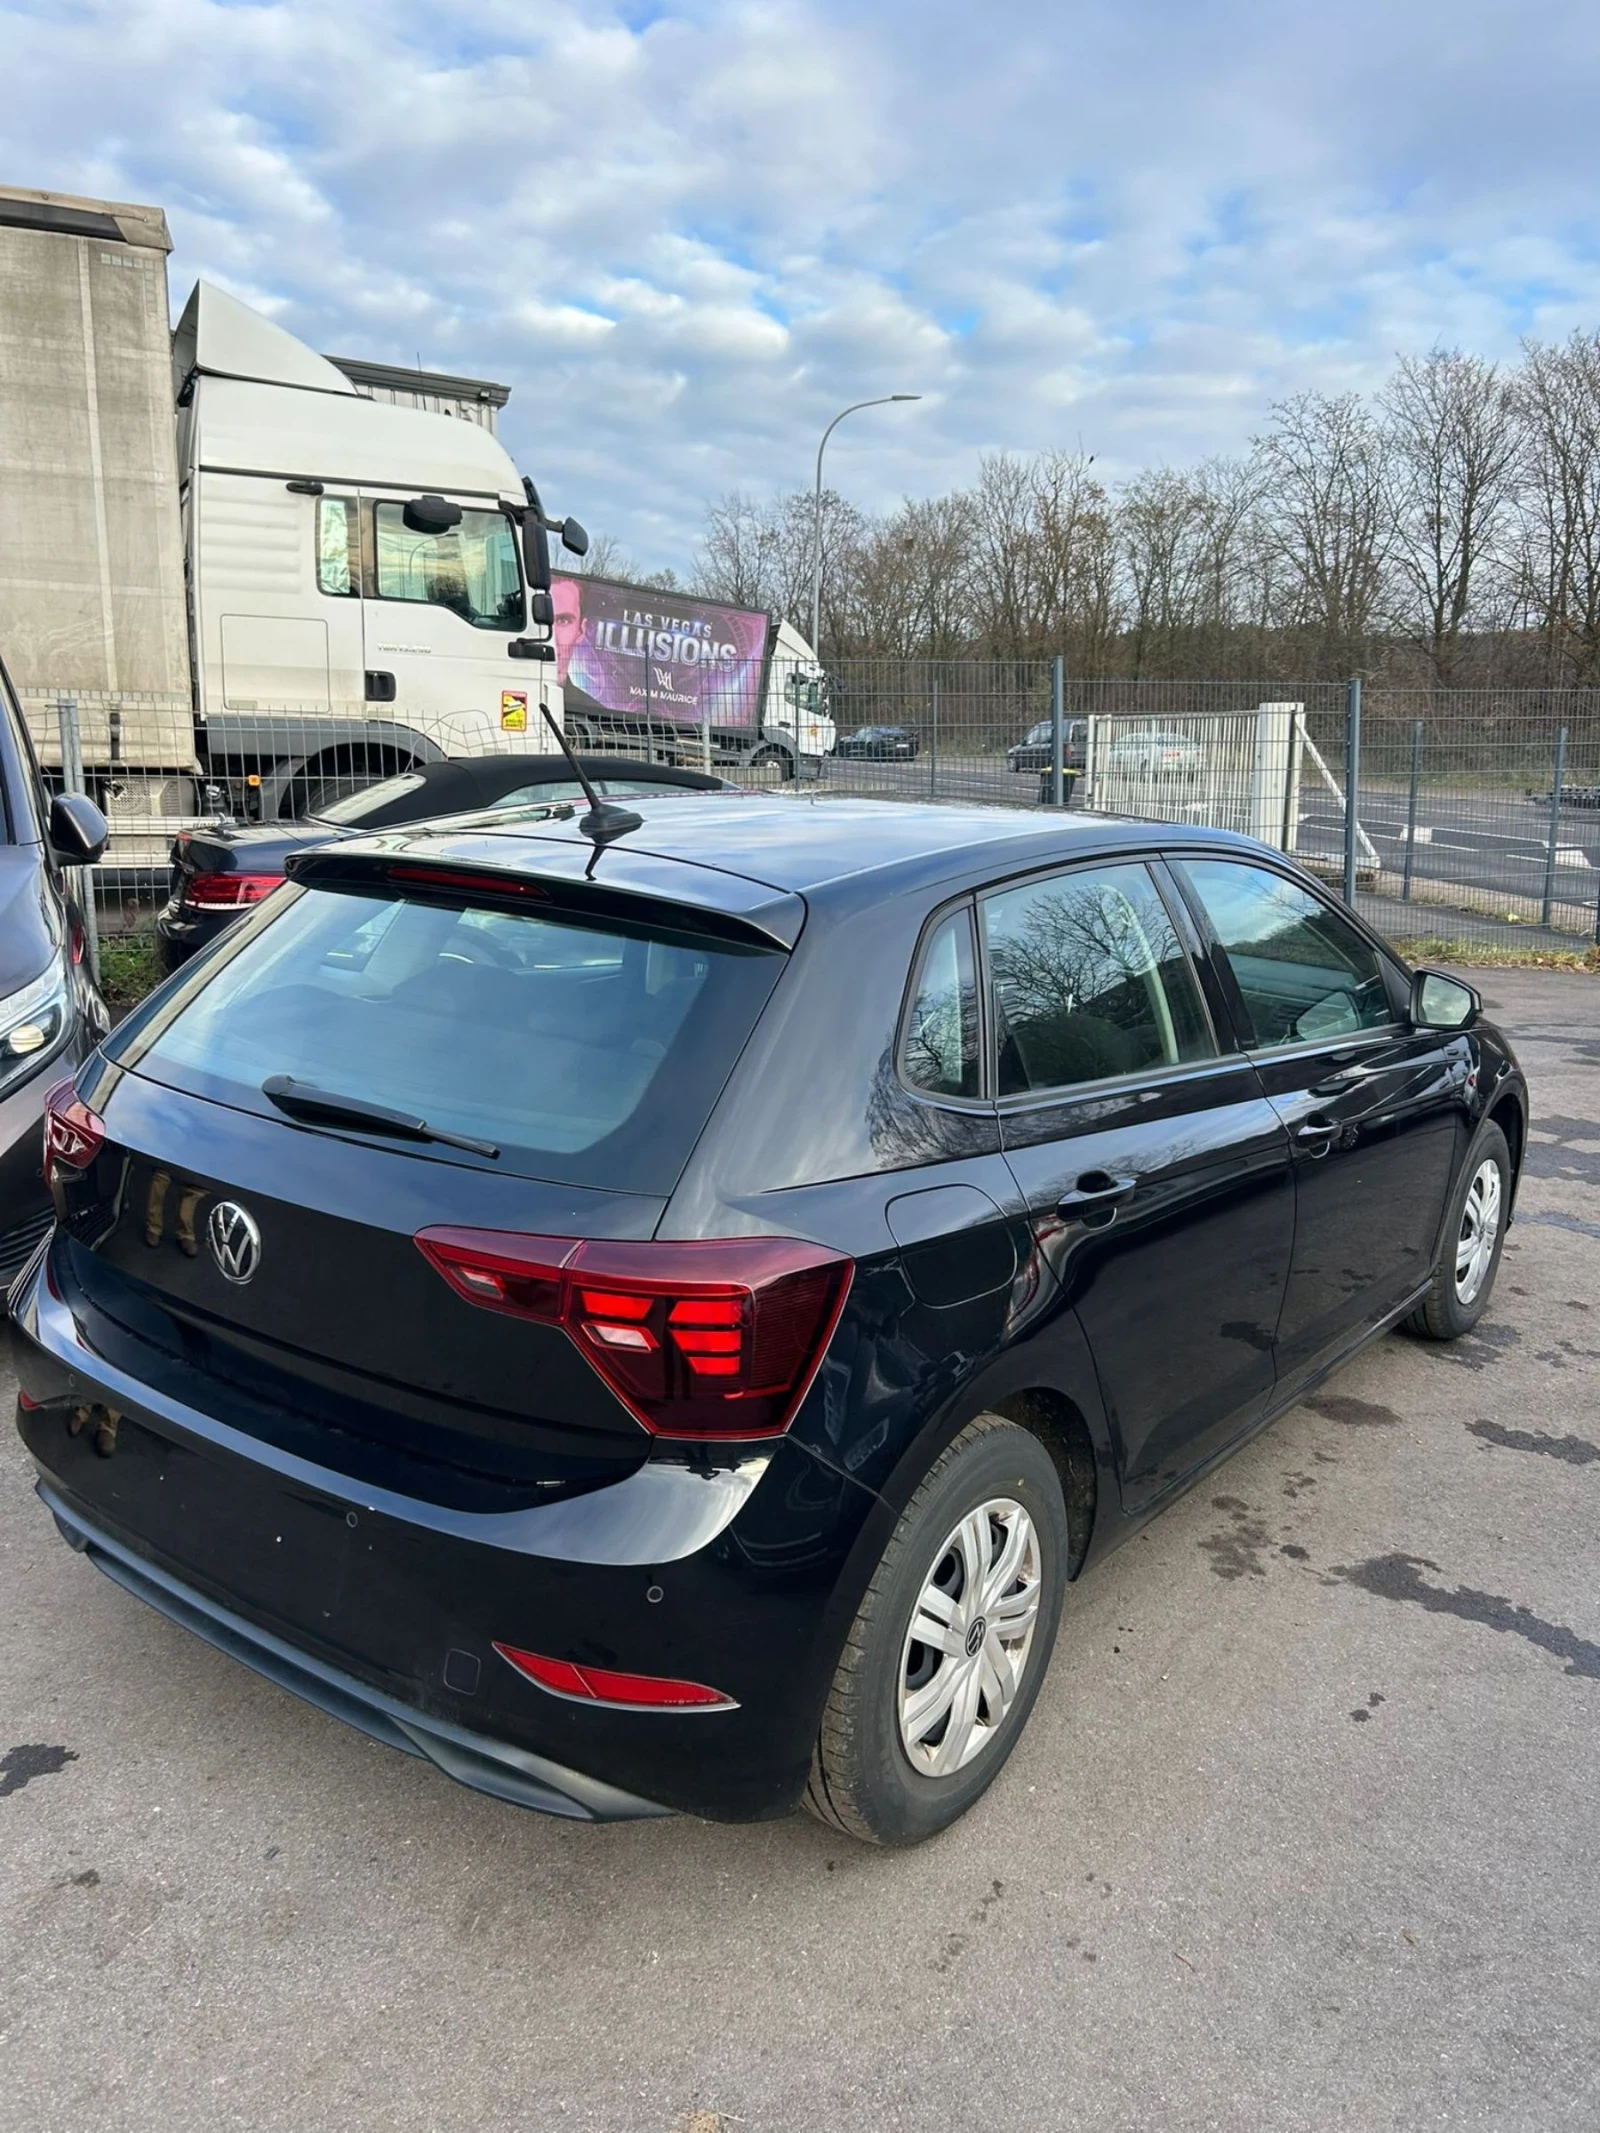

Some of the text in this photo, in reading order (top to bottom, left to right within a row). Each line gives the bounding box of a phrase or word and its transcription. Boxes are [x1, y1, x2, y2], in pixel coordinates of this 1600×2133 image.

[622, 609, 712, 638] LAS VEGAS
[594, 621, 737, 672] ILLUSIONS
[629, 686, 698, 705] MAXM MAURICE
[208, 1201, 260, 1283] VW
